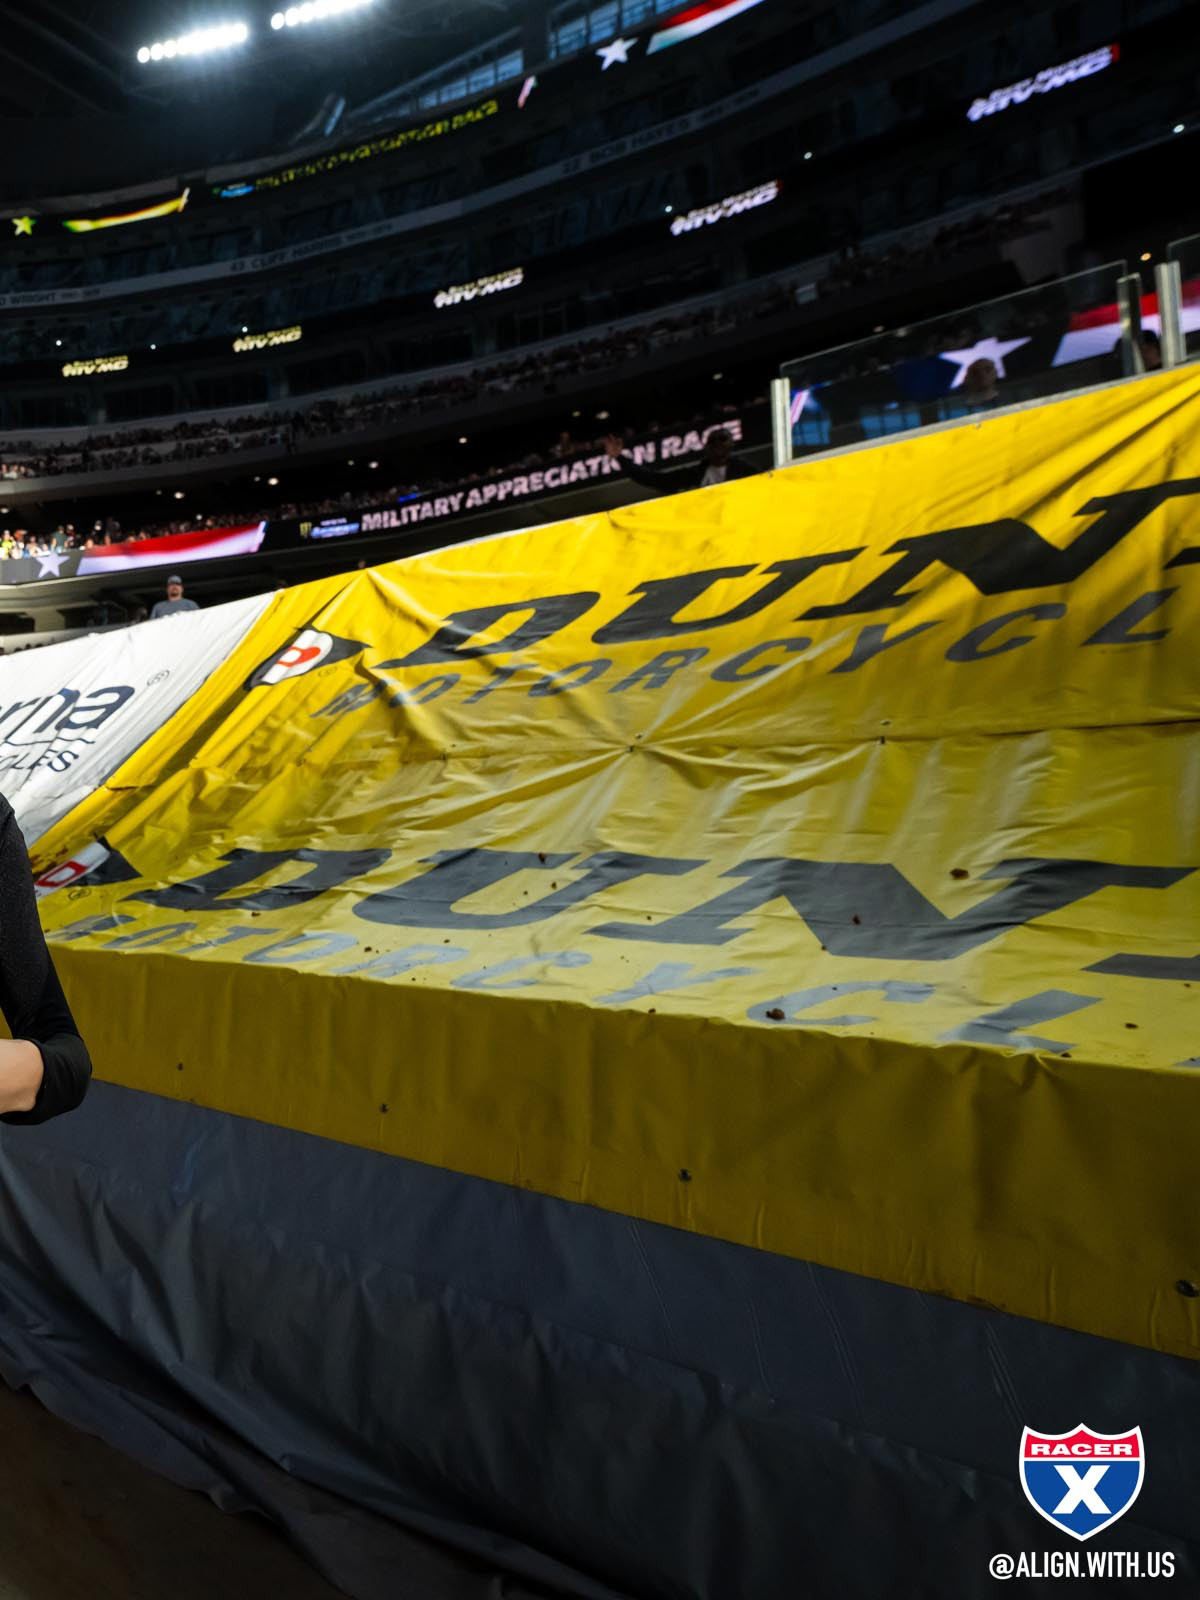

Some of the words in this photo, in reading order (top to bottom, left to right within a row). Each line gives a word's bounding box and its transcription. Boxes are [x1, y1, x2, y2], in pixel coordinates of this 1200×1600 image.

[361, 491, 464, 532] MILITARY
[371, 477, 1200, 669] DUN
[120, 848, 1200, 981] DUN
[45, 914, 1200, 1067] MOTORCYCL
